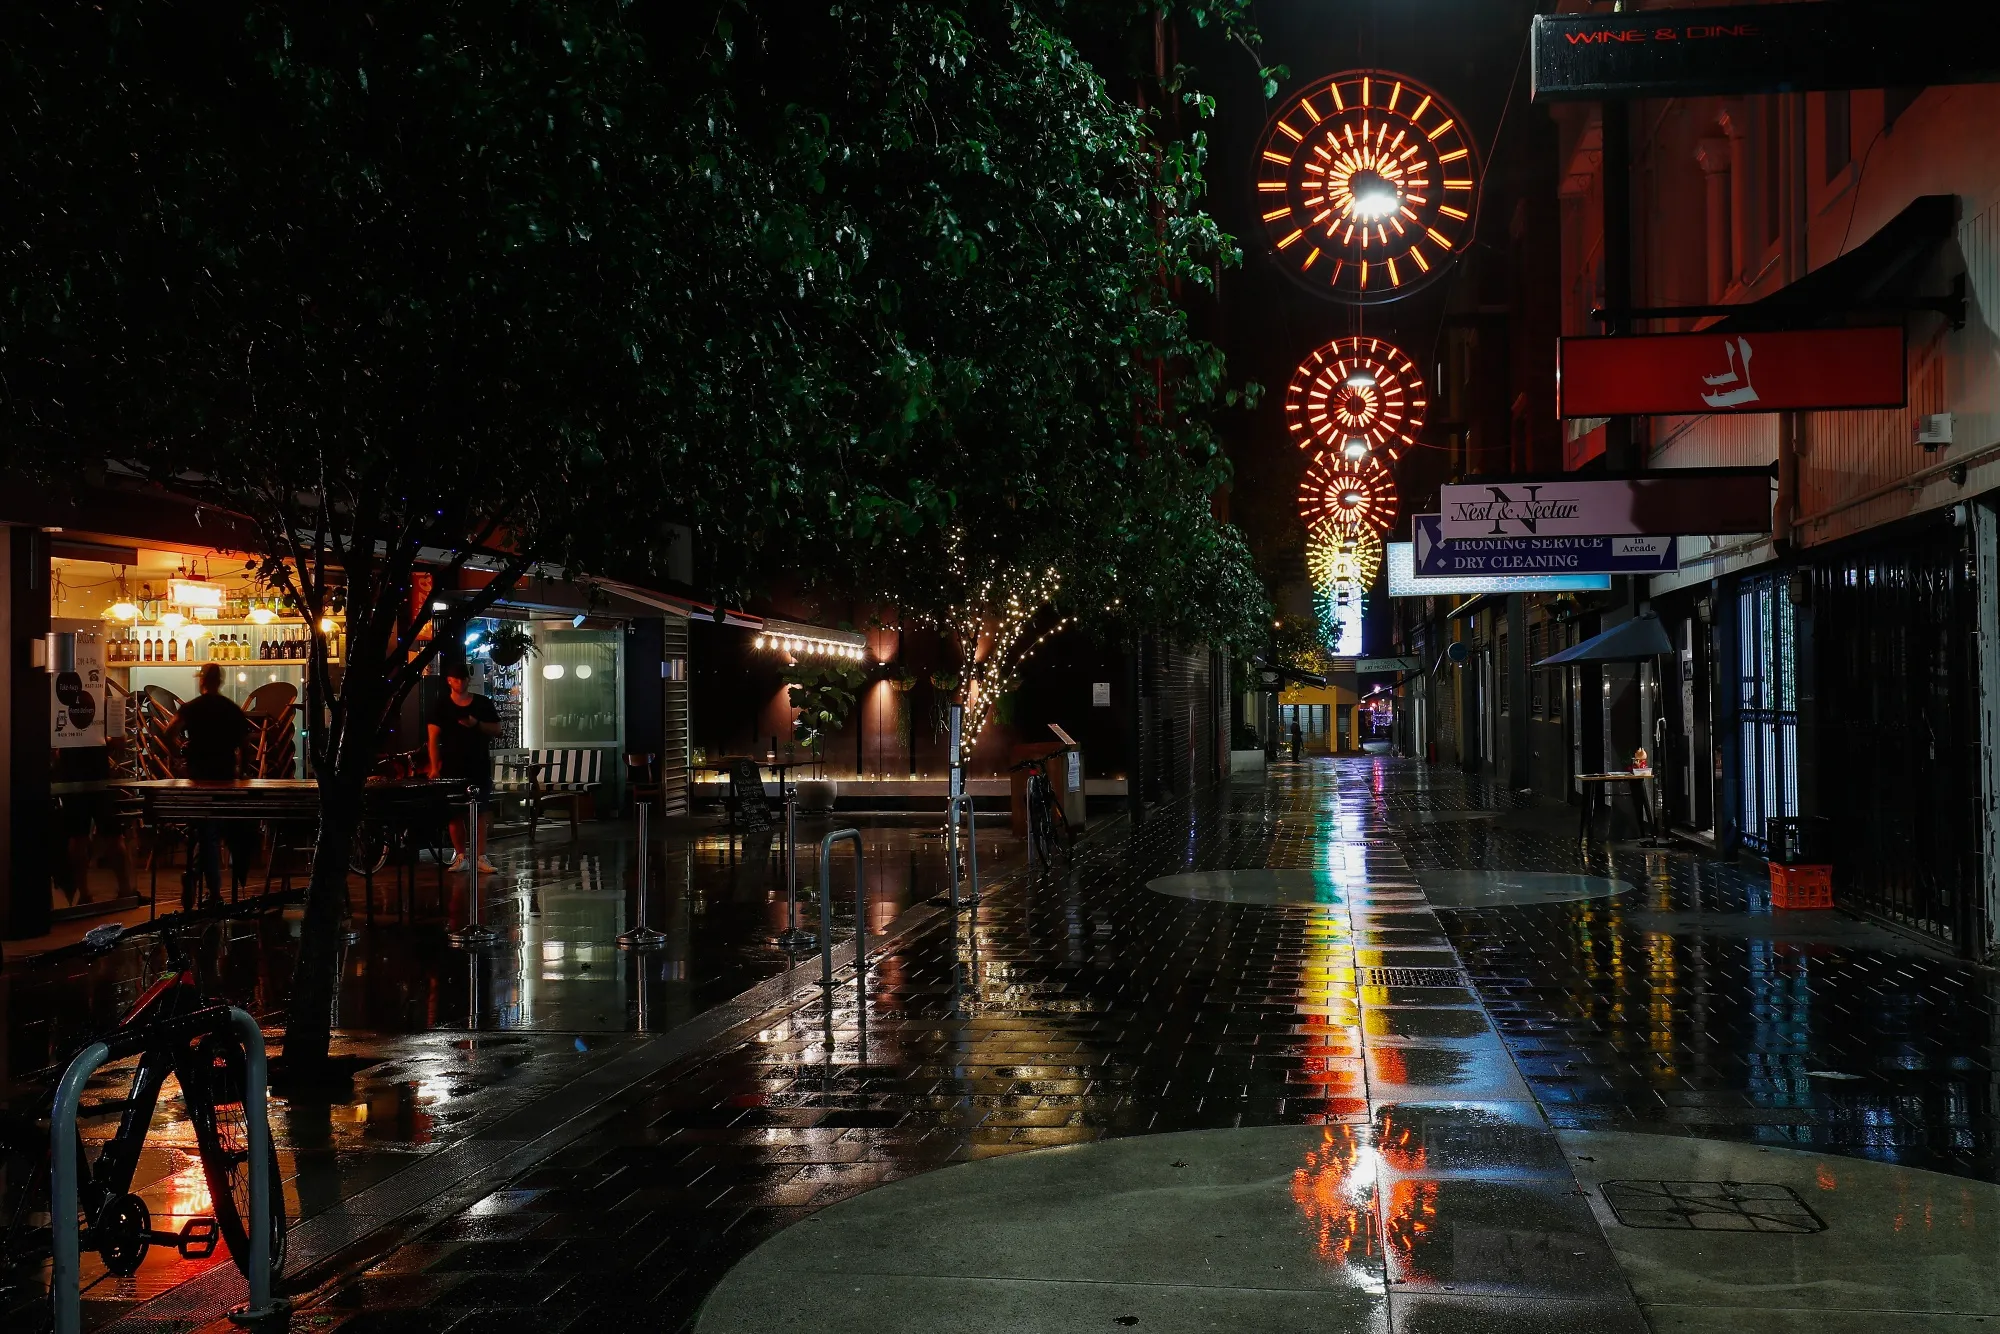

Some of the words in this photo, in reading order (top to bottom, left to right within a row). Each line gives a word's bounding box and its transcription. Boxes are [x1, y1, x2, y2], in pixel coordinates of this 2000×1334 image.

[1565, 30, 1647, 45] WINE
[1654, 28, 1677, 40] &
[1685, 24, 1761, 39] DINE
[1451, 501, 1494, 521] Nest
[1497, 501, 1514, 520] &
[1516, 499, 1579, 520] Nectar
[1454, 539, 1528, 551] IRONING
[1531, 537, 1604, 549] SERVICE
[1622, 544, 1656, 553] Arcade
[1454, 556, 1487, 569] DRY
[1490, 554, 1579, 569] CLEANING
